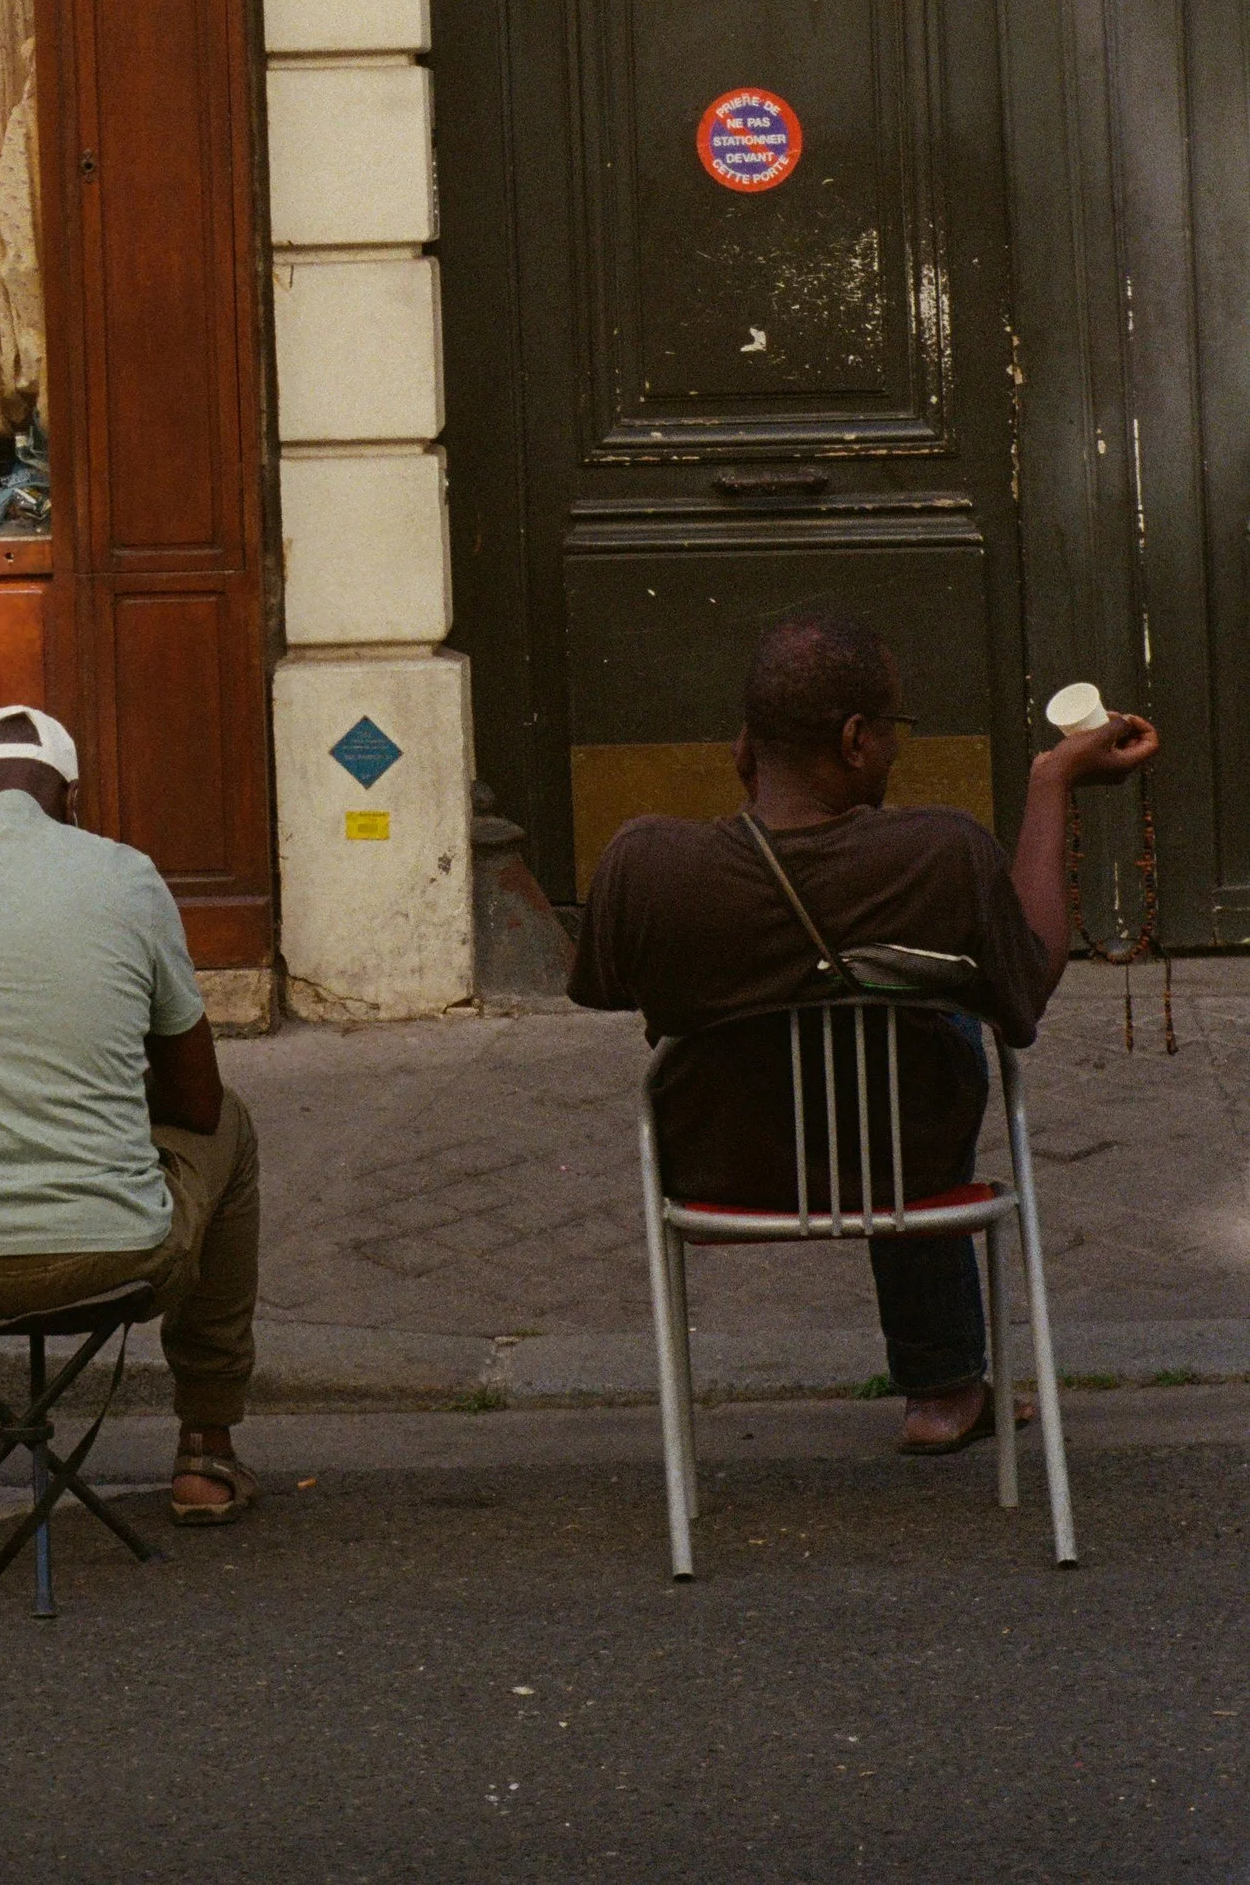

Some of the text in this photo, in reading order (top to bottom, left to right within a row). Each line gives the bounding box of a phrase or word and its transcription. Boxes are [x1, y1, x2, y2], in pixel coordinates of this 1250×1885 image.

[763, 100, 781, 117] DE
[726, 117, 771, 129] NE PAS
[713, 134, 786, 147] STATIONNER
[726, 152, 774, 164] DEVANT
[712, 155, 789, 185] CETTE PORTE
